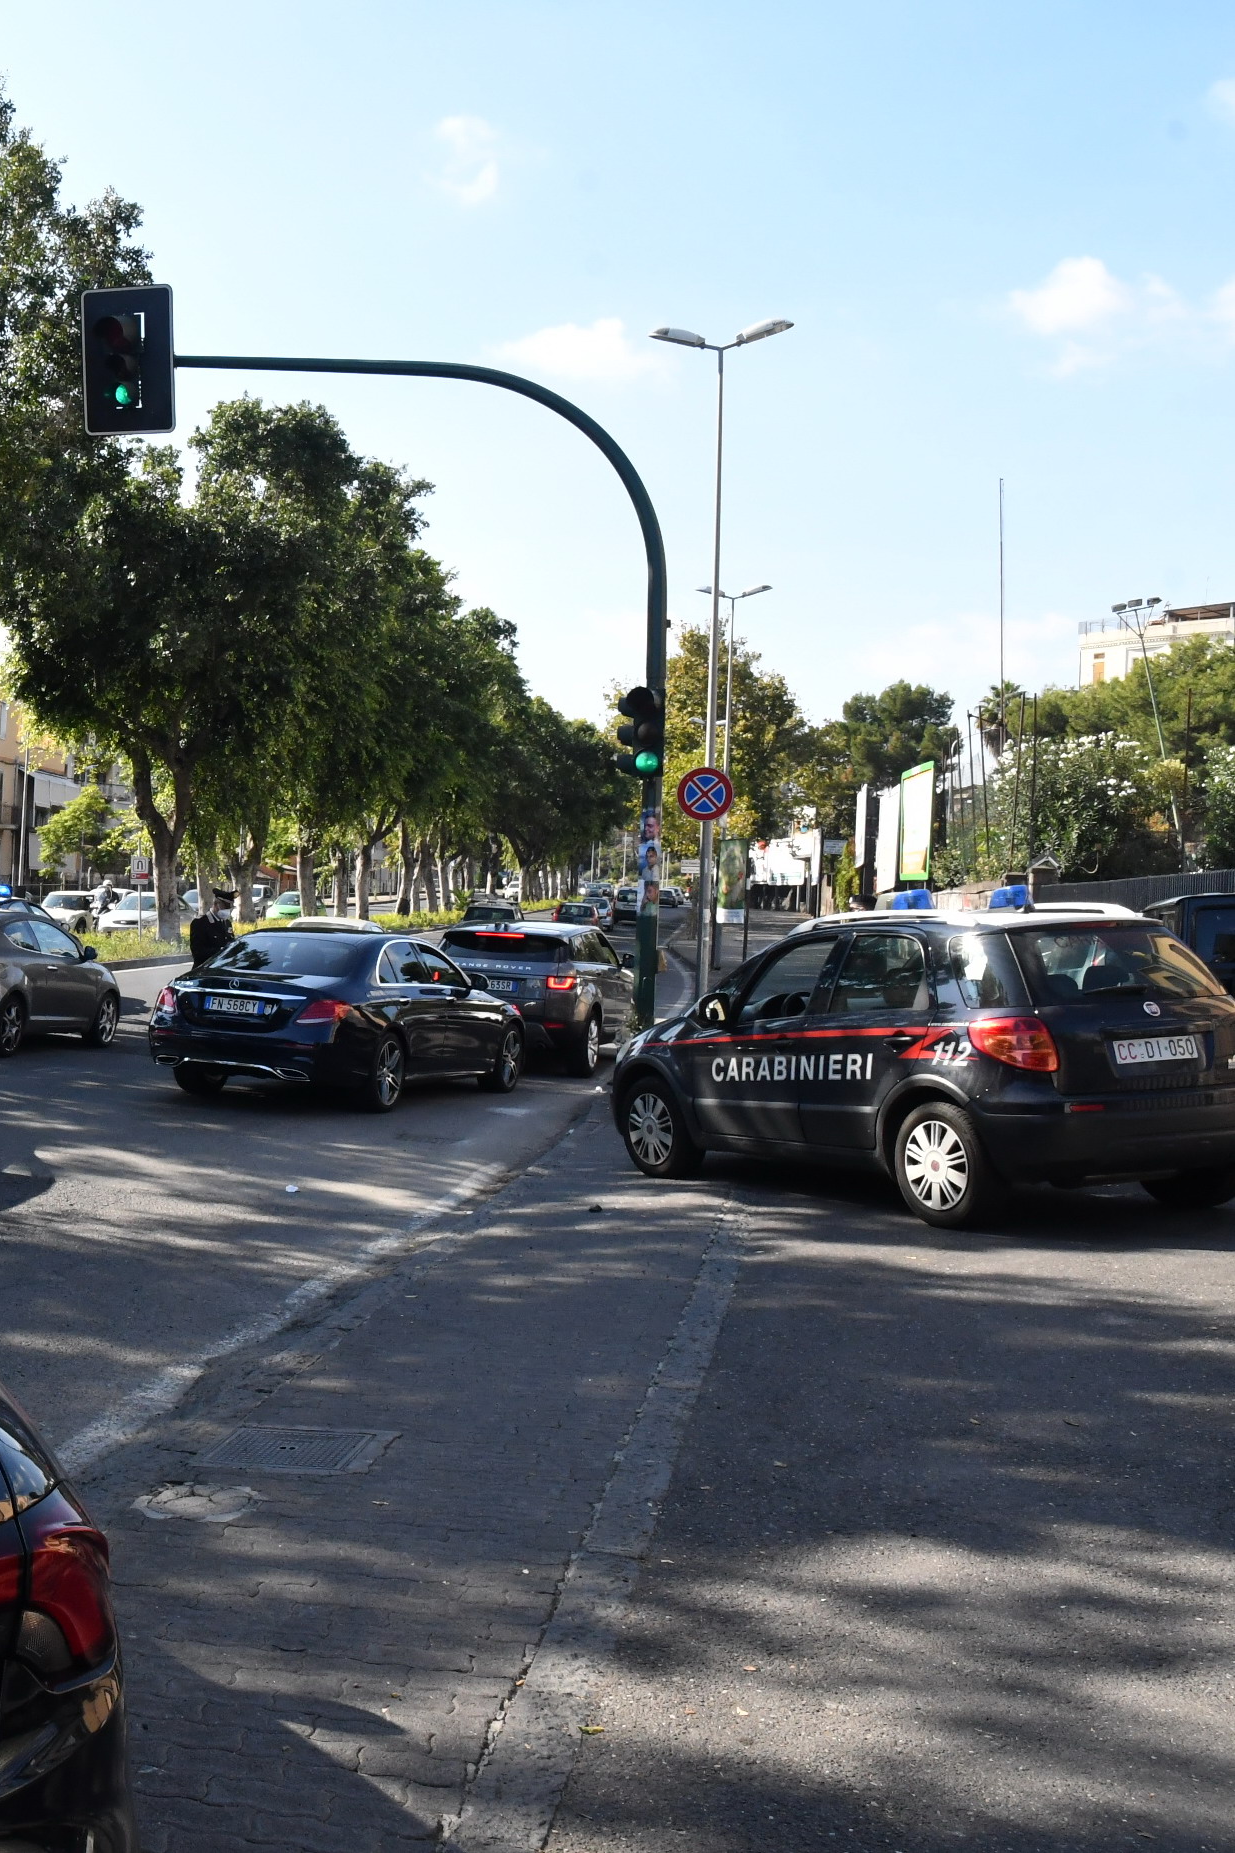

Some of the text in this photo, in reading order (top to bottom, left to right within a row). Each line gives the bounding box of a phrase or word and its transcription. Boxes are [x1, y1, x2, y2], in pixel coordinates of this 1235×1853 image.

[490, 981, 511, 990] 63SR
[211, 998, 223, 1010] FN
[226, 999, 257, 1012] 568CY
[931, 1041, 972, 1067] 112
[1117, 1038, 1194, 1061] CC DI 050
[711, 1052, 874, 1082] CARABINIERI
